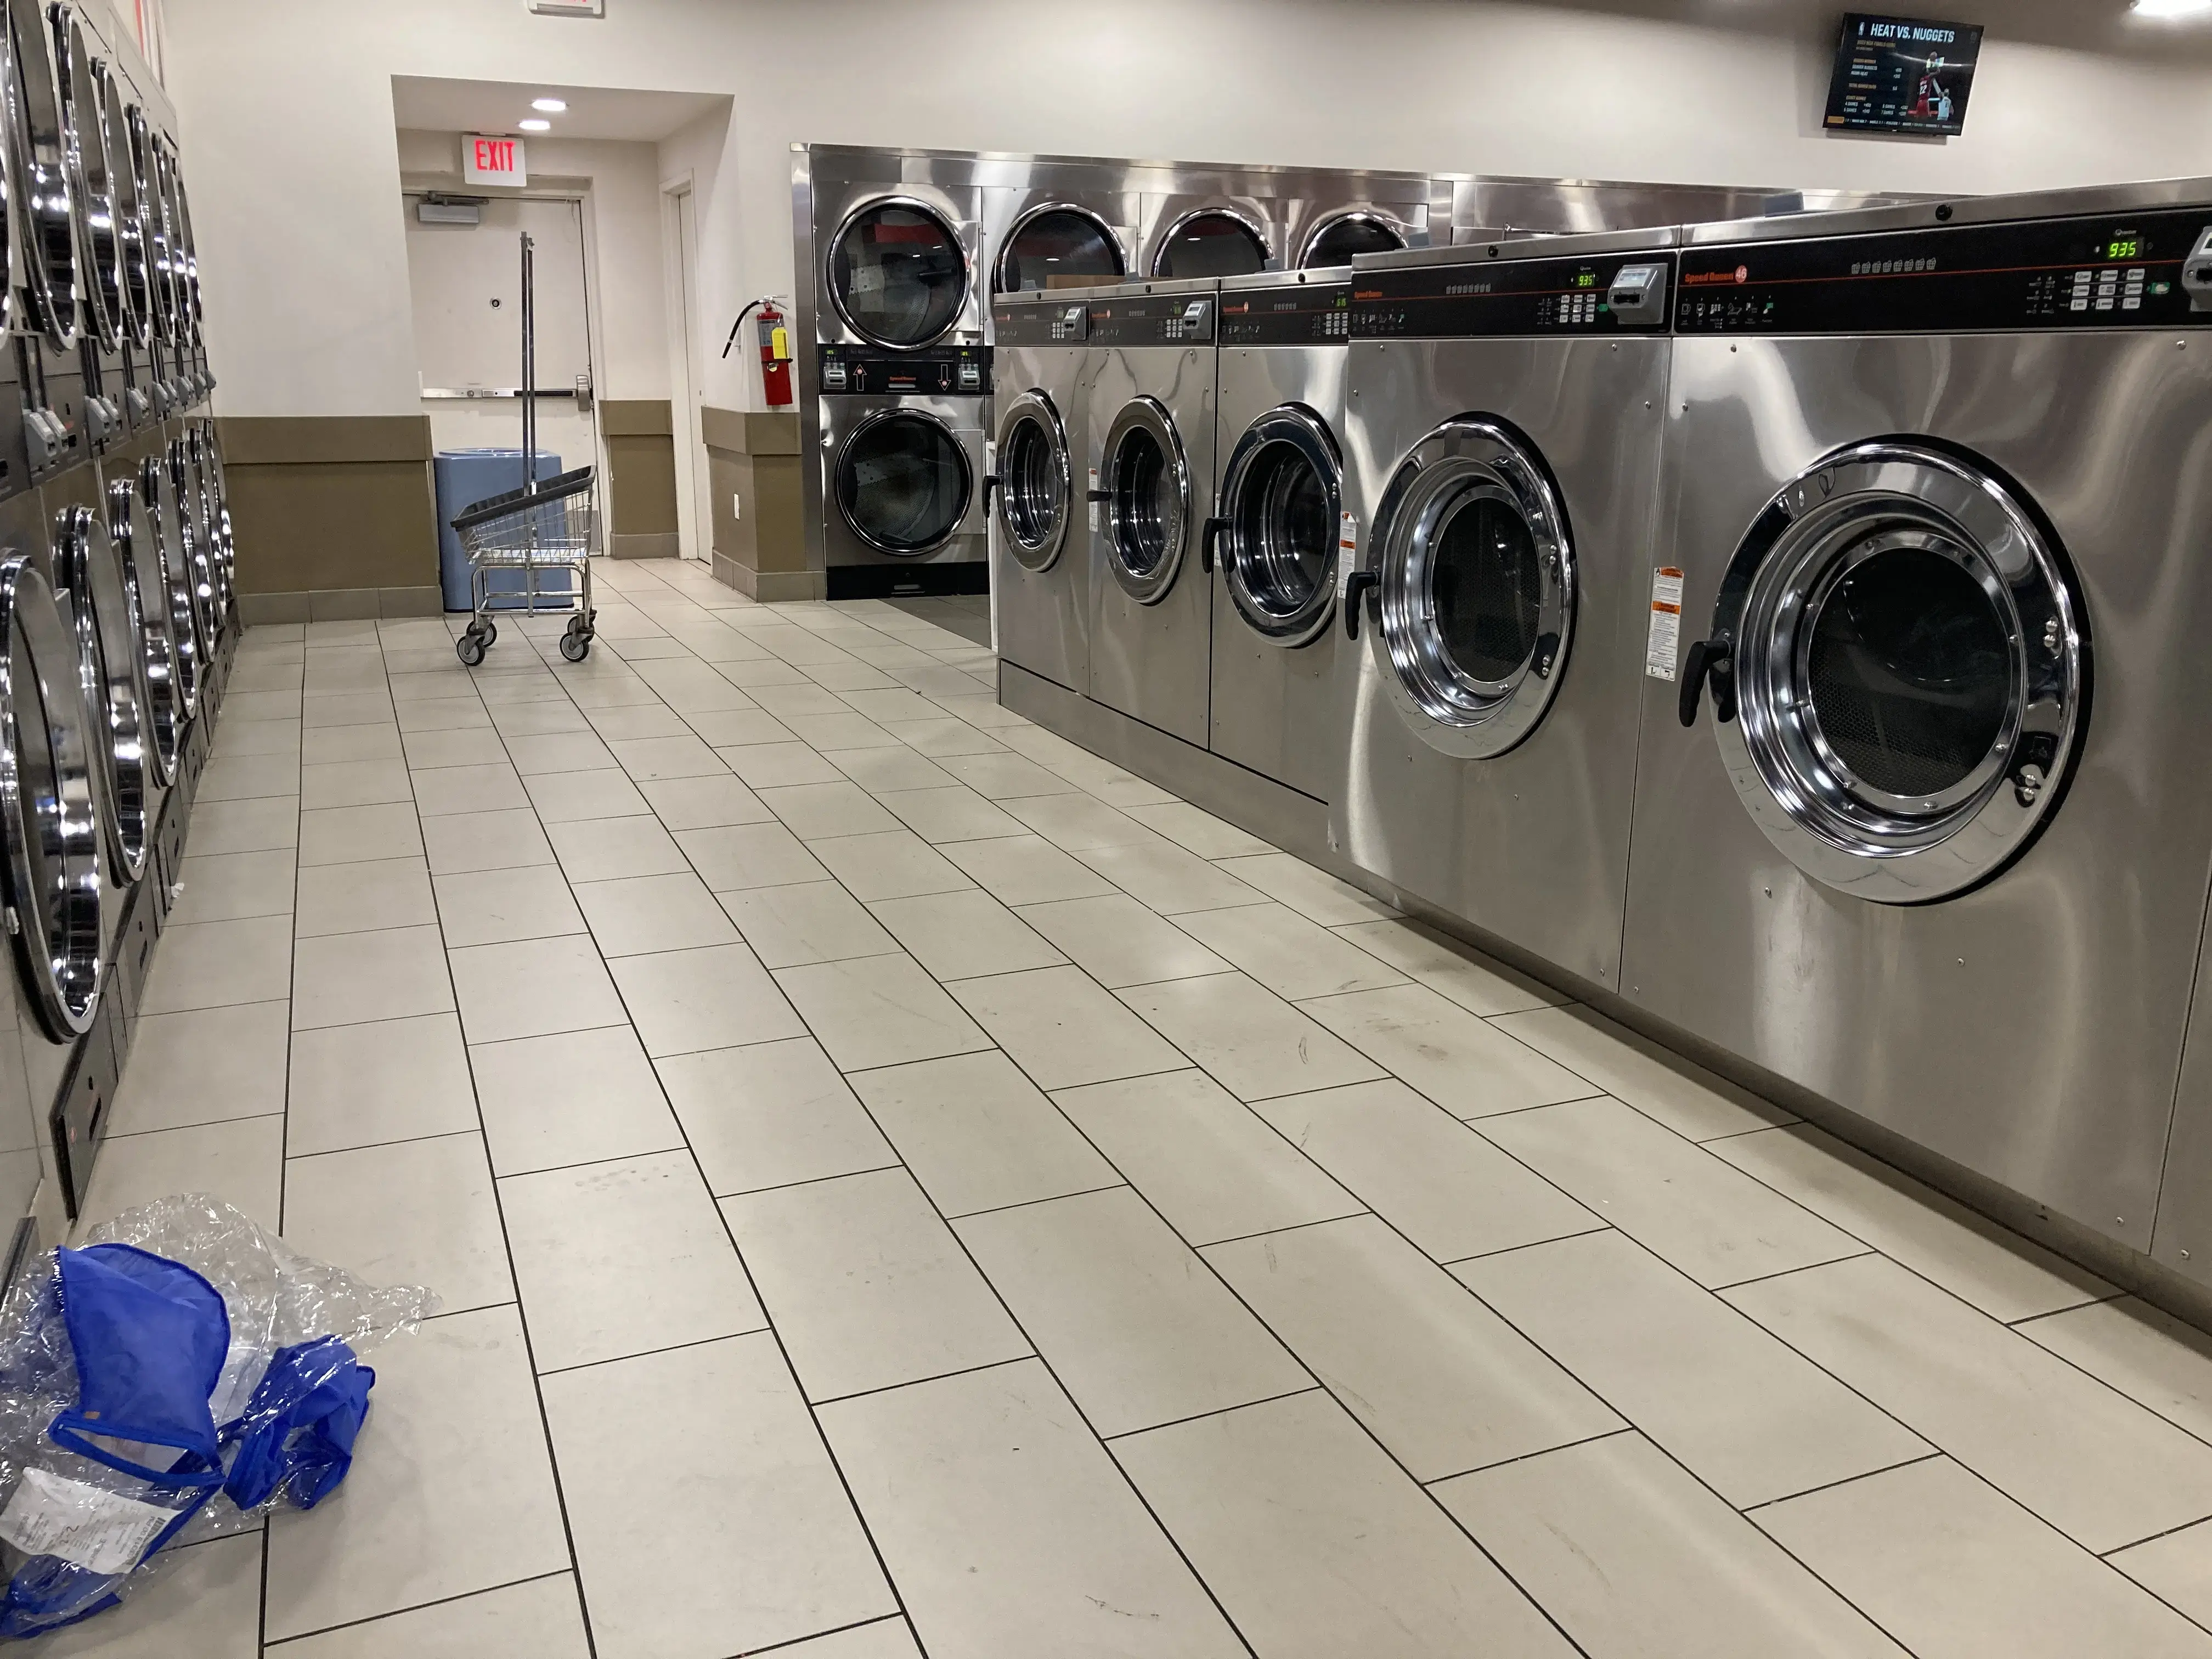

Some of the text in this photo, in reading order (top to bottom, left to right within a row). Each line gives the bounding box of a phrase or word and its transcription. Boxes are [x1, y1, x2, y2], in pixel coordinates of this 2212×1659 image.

[1870, 23, 1955, 43] HEAT VS. NUGGETS
[475, 140, 515, 172] EXIT
[2108, 242, 2137, 258] 935
[1579, 275, 1593, 286] 935
[1685, 272, 1708, 284] Speed
[1735, 268, 1747, 279] 46
